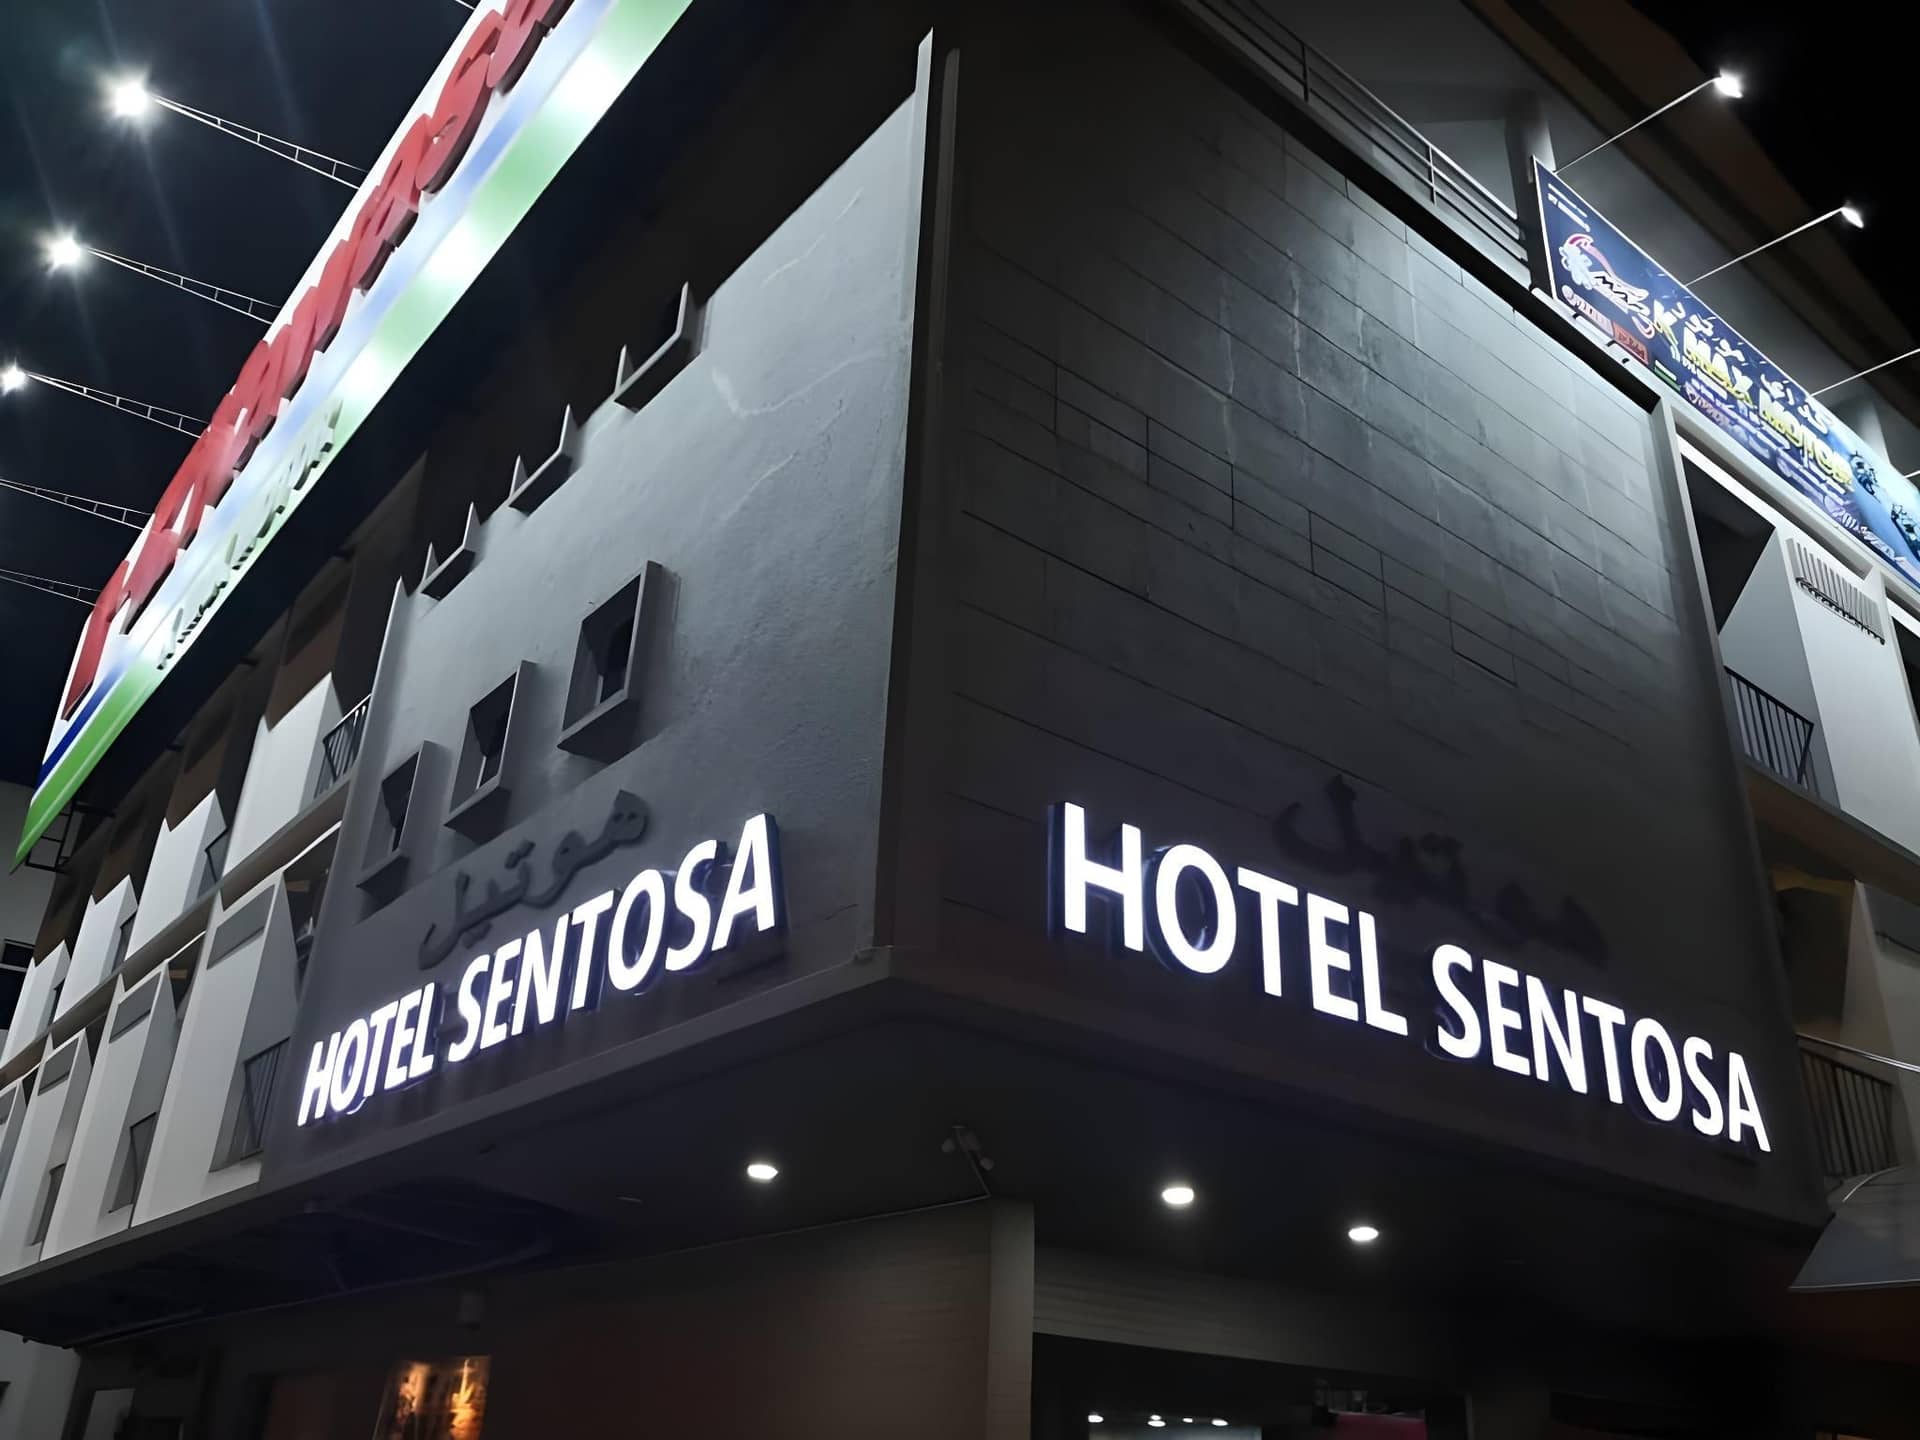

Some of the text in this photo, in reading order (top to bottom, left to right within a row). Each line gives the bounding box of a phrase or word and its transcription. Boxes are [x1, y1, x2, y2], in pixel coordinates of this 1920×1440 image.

[1683, 326, 1754, 406] MAX
[1758, 387, 1853, 486] MOTOR
[296, 812, 776, 1126] HOTEL SENTOSA
[1063, 801, 1772, 1153] HOTEL SENTOSA
